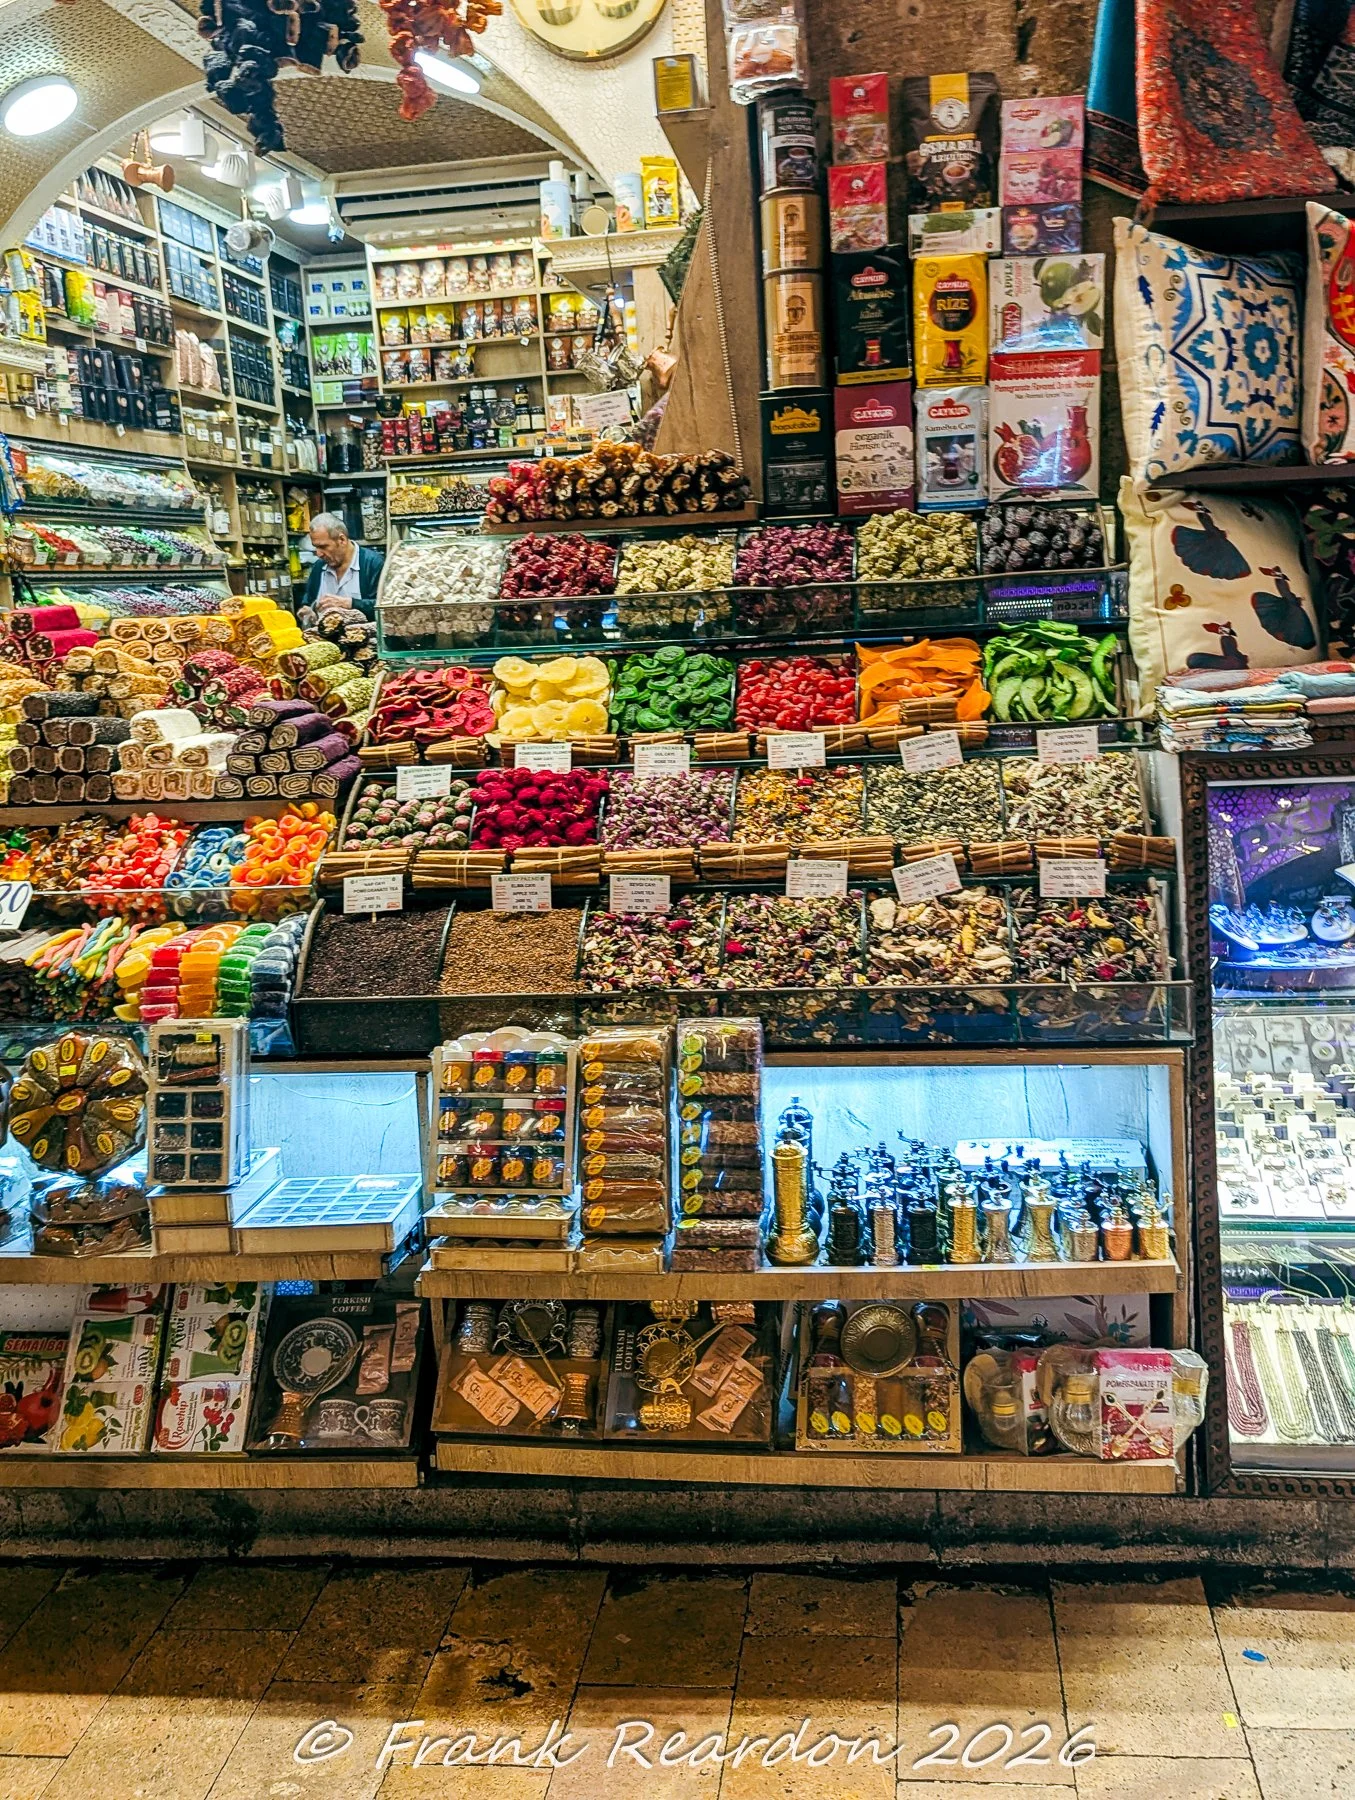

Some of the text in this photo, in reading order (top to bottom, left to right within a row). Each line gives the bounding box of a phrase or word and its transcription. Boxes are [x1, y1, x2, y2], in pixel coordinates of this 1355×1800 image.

[936, 297, 970, 310] RİZE
[854, 430, 894, 442] organik
[332, 1296, 371, 1304] TURKISH
[171, 1316, 186, 1348] Kiwi
[615, 1330, 626, 1372] TURKISH
[624, 1332, 635, 1370] COFFEE
[1106, 1380, 1154, 1388] POMEGRANATE
[172, 1400, 189, 1439] Rosehip
